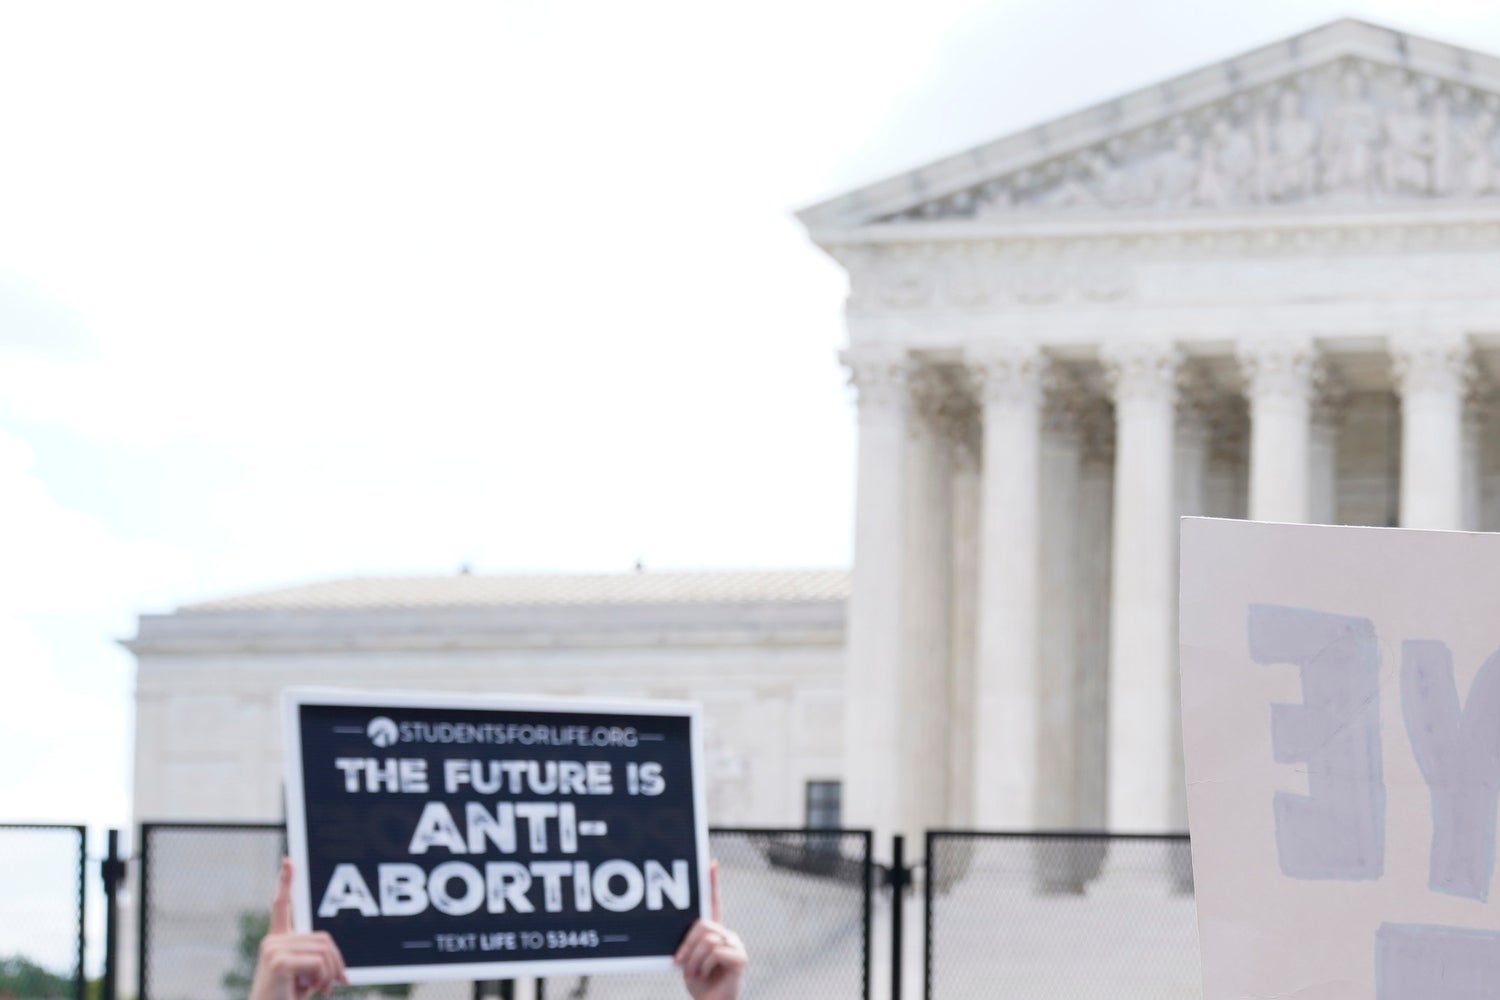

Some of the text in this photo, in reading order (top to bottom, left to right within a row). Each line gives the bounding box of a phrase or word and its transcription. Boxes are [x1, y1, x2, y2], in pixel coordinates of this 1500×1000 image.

[400, 721, 638, 748] STUDENTSFORLIFE.ORG
[335, 758, 666, 796] THE FUTURE IS
[408, 801, 607, 855] ANTI-
[317, 859, 692, 918] ABORTION
[436, 929, 599, 953] TEXT LIFE TO 53445
